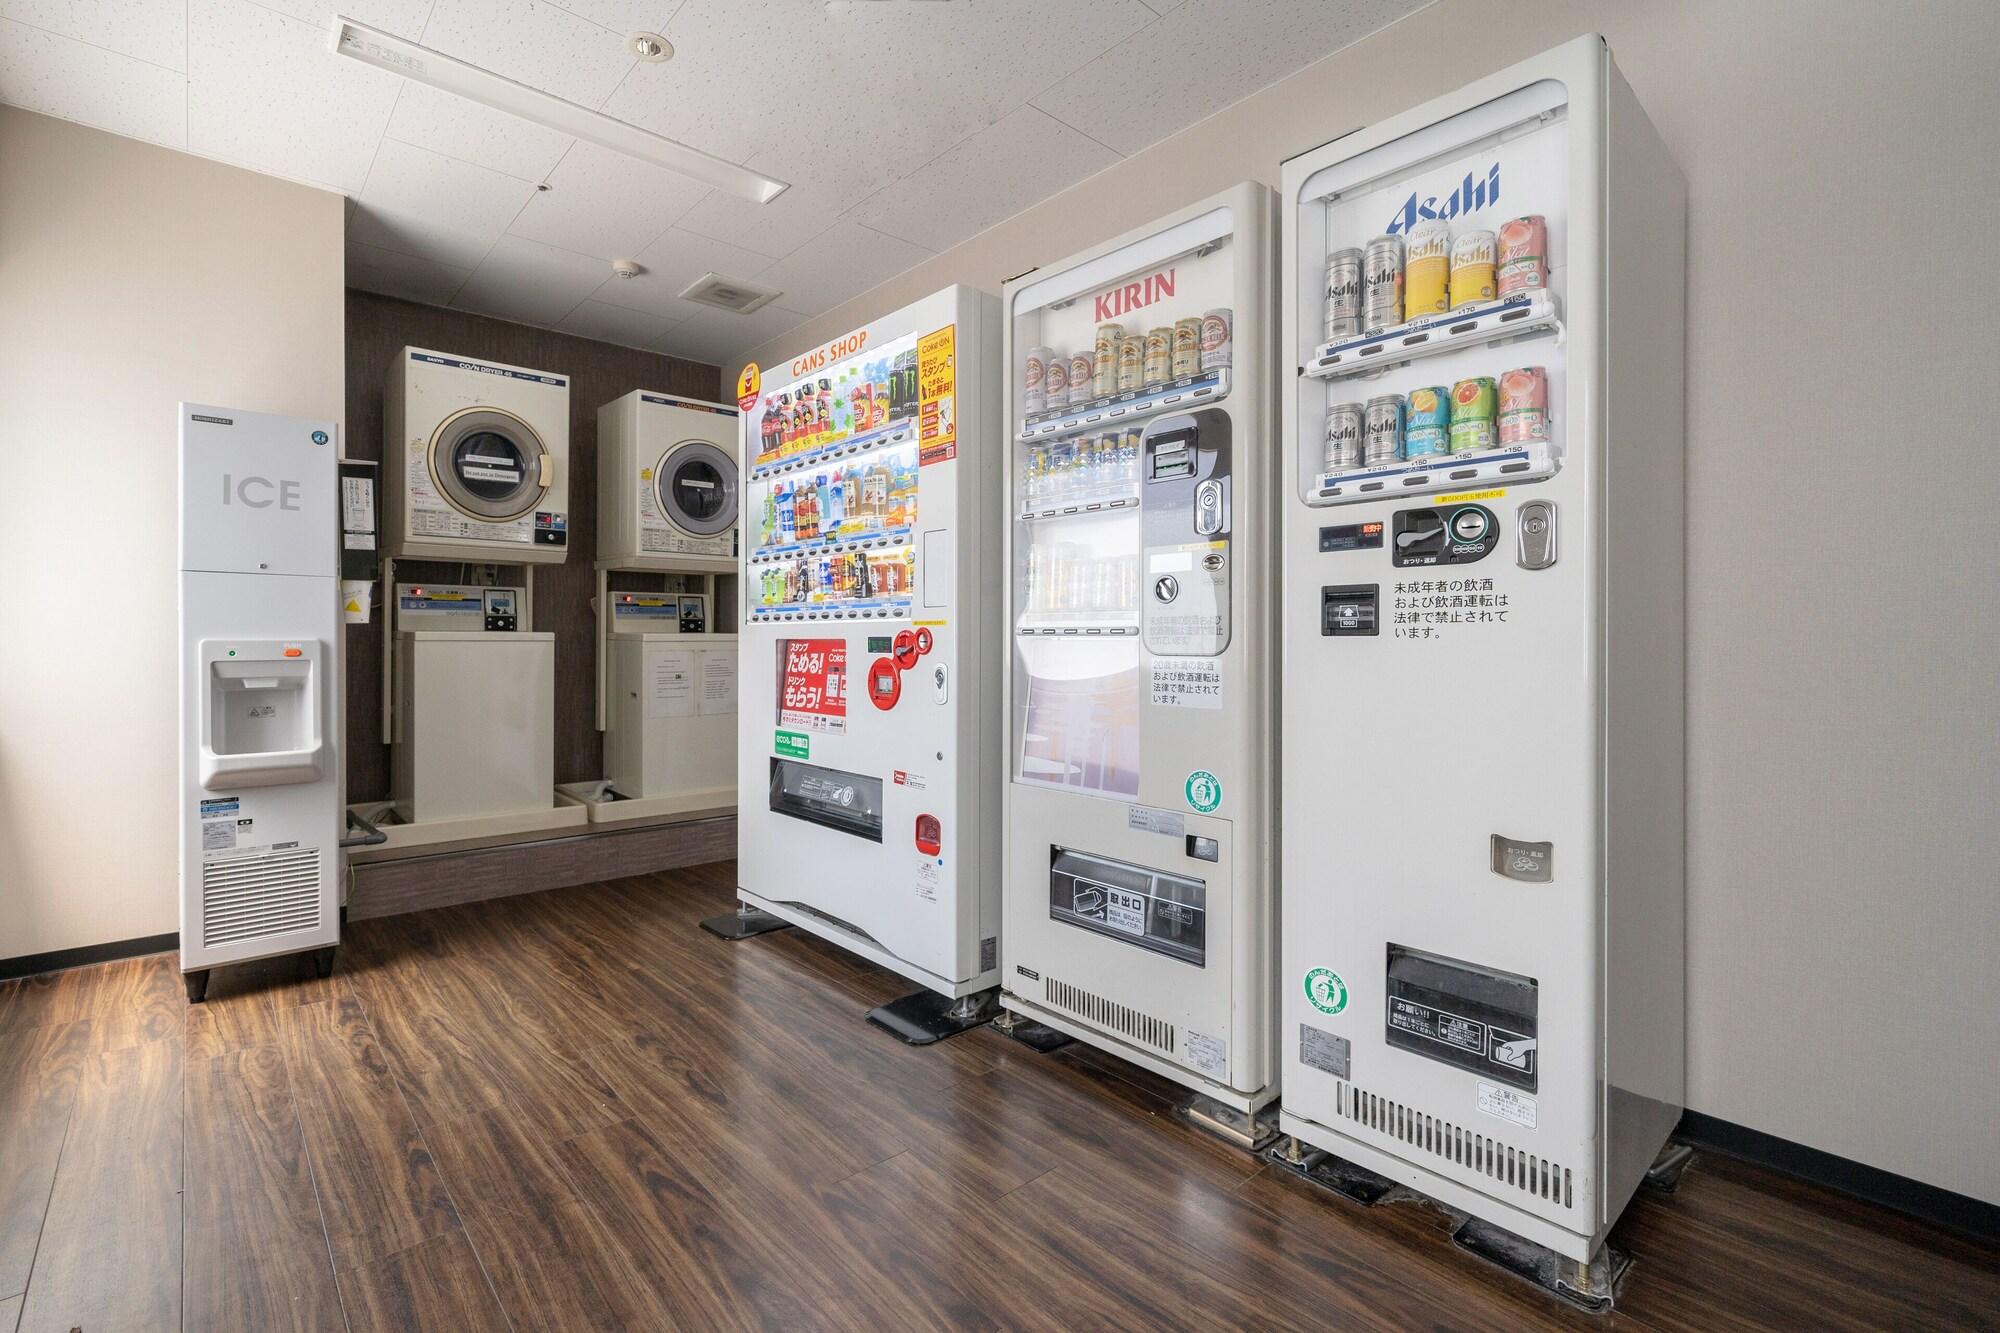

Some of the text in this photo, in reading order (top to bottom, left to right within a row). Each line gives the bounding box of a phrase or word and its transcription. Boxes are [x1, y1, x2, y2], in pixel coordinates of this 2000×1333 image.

[1386, 161, 1500, 235] Asahi
[1094, 268, 1176, 324] KIRIN
[792, 331, 867, 377] CANS SHOP
[223, 474, 301, 511] ICE
[1394, 578, 1494, 594] 未成年者の飲酒
[1394, 593, 1509, 609] および飲酒運転は
[1393, 609, 1510, 624] 法律で禁止されて
[1395, 626, 1440, 640] います。
[790, 643, 809, 653] スタンプ
[787, 652, 825, 675] ためる!
[787, 676, 806, 686] ドリンク
[1153, 671, 1221, 684] および飲酒運転は
[785, 685, 822, 710] もらう!
[1153, 683, 1220, 696] 法律で禁止されて
[1153, 695, 1182, 705] います。
[1110, 891, 1141, 911] 取出口
